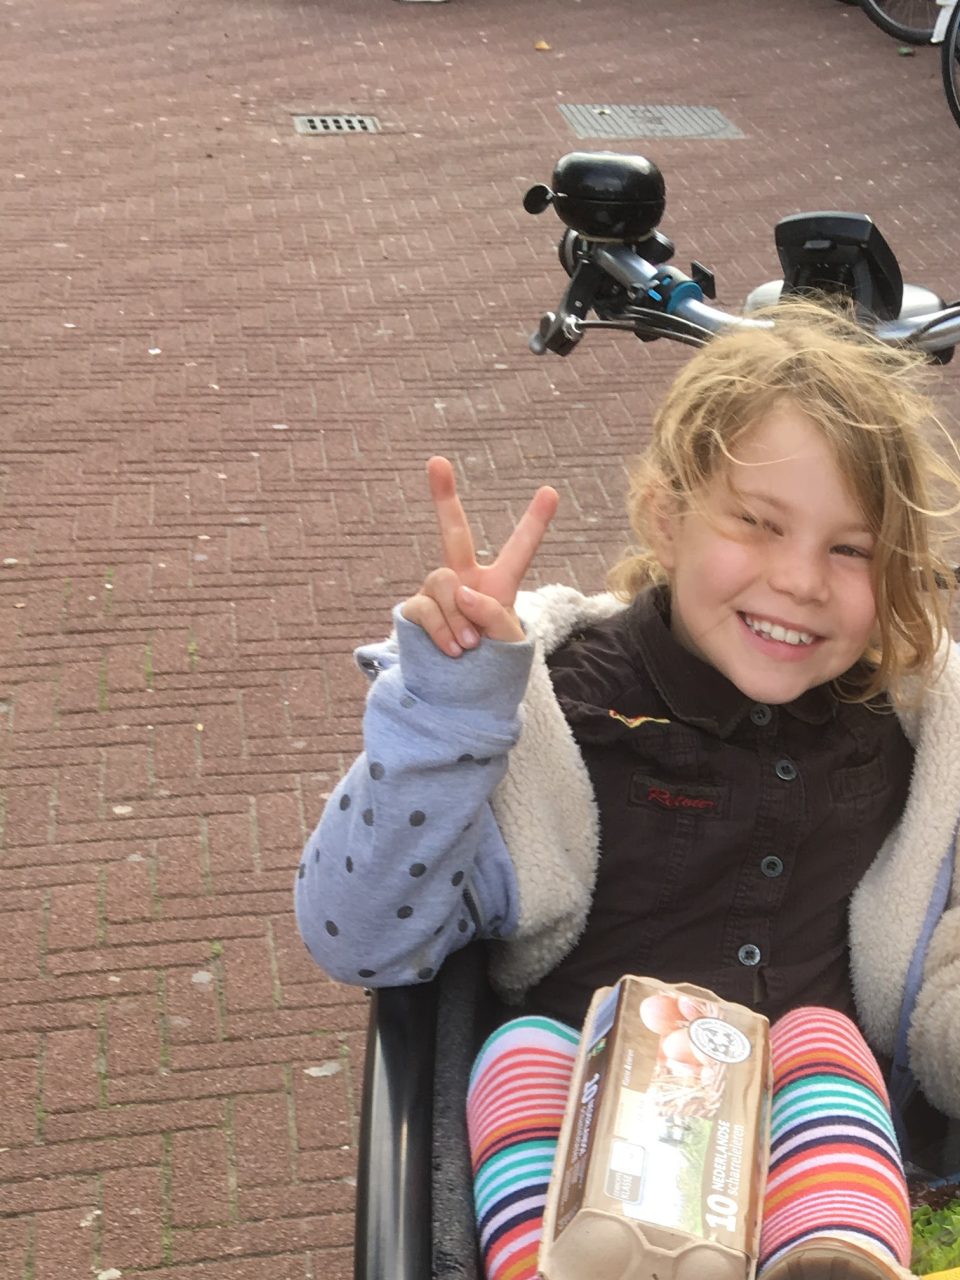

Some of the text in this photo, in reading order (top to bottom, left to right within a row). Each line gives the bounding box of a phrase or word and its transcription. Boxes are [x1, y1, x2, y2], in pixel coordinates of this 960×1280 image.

[711, 1120, 730, 1191] NEDERLANDSE
[727, 1124, 744, 1196] scharreleieren
[705, 1194, 739, 1232] 10
